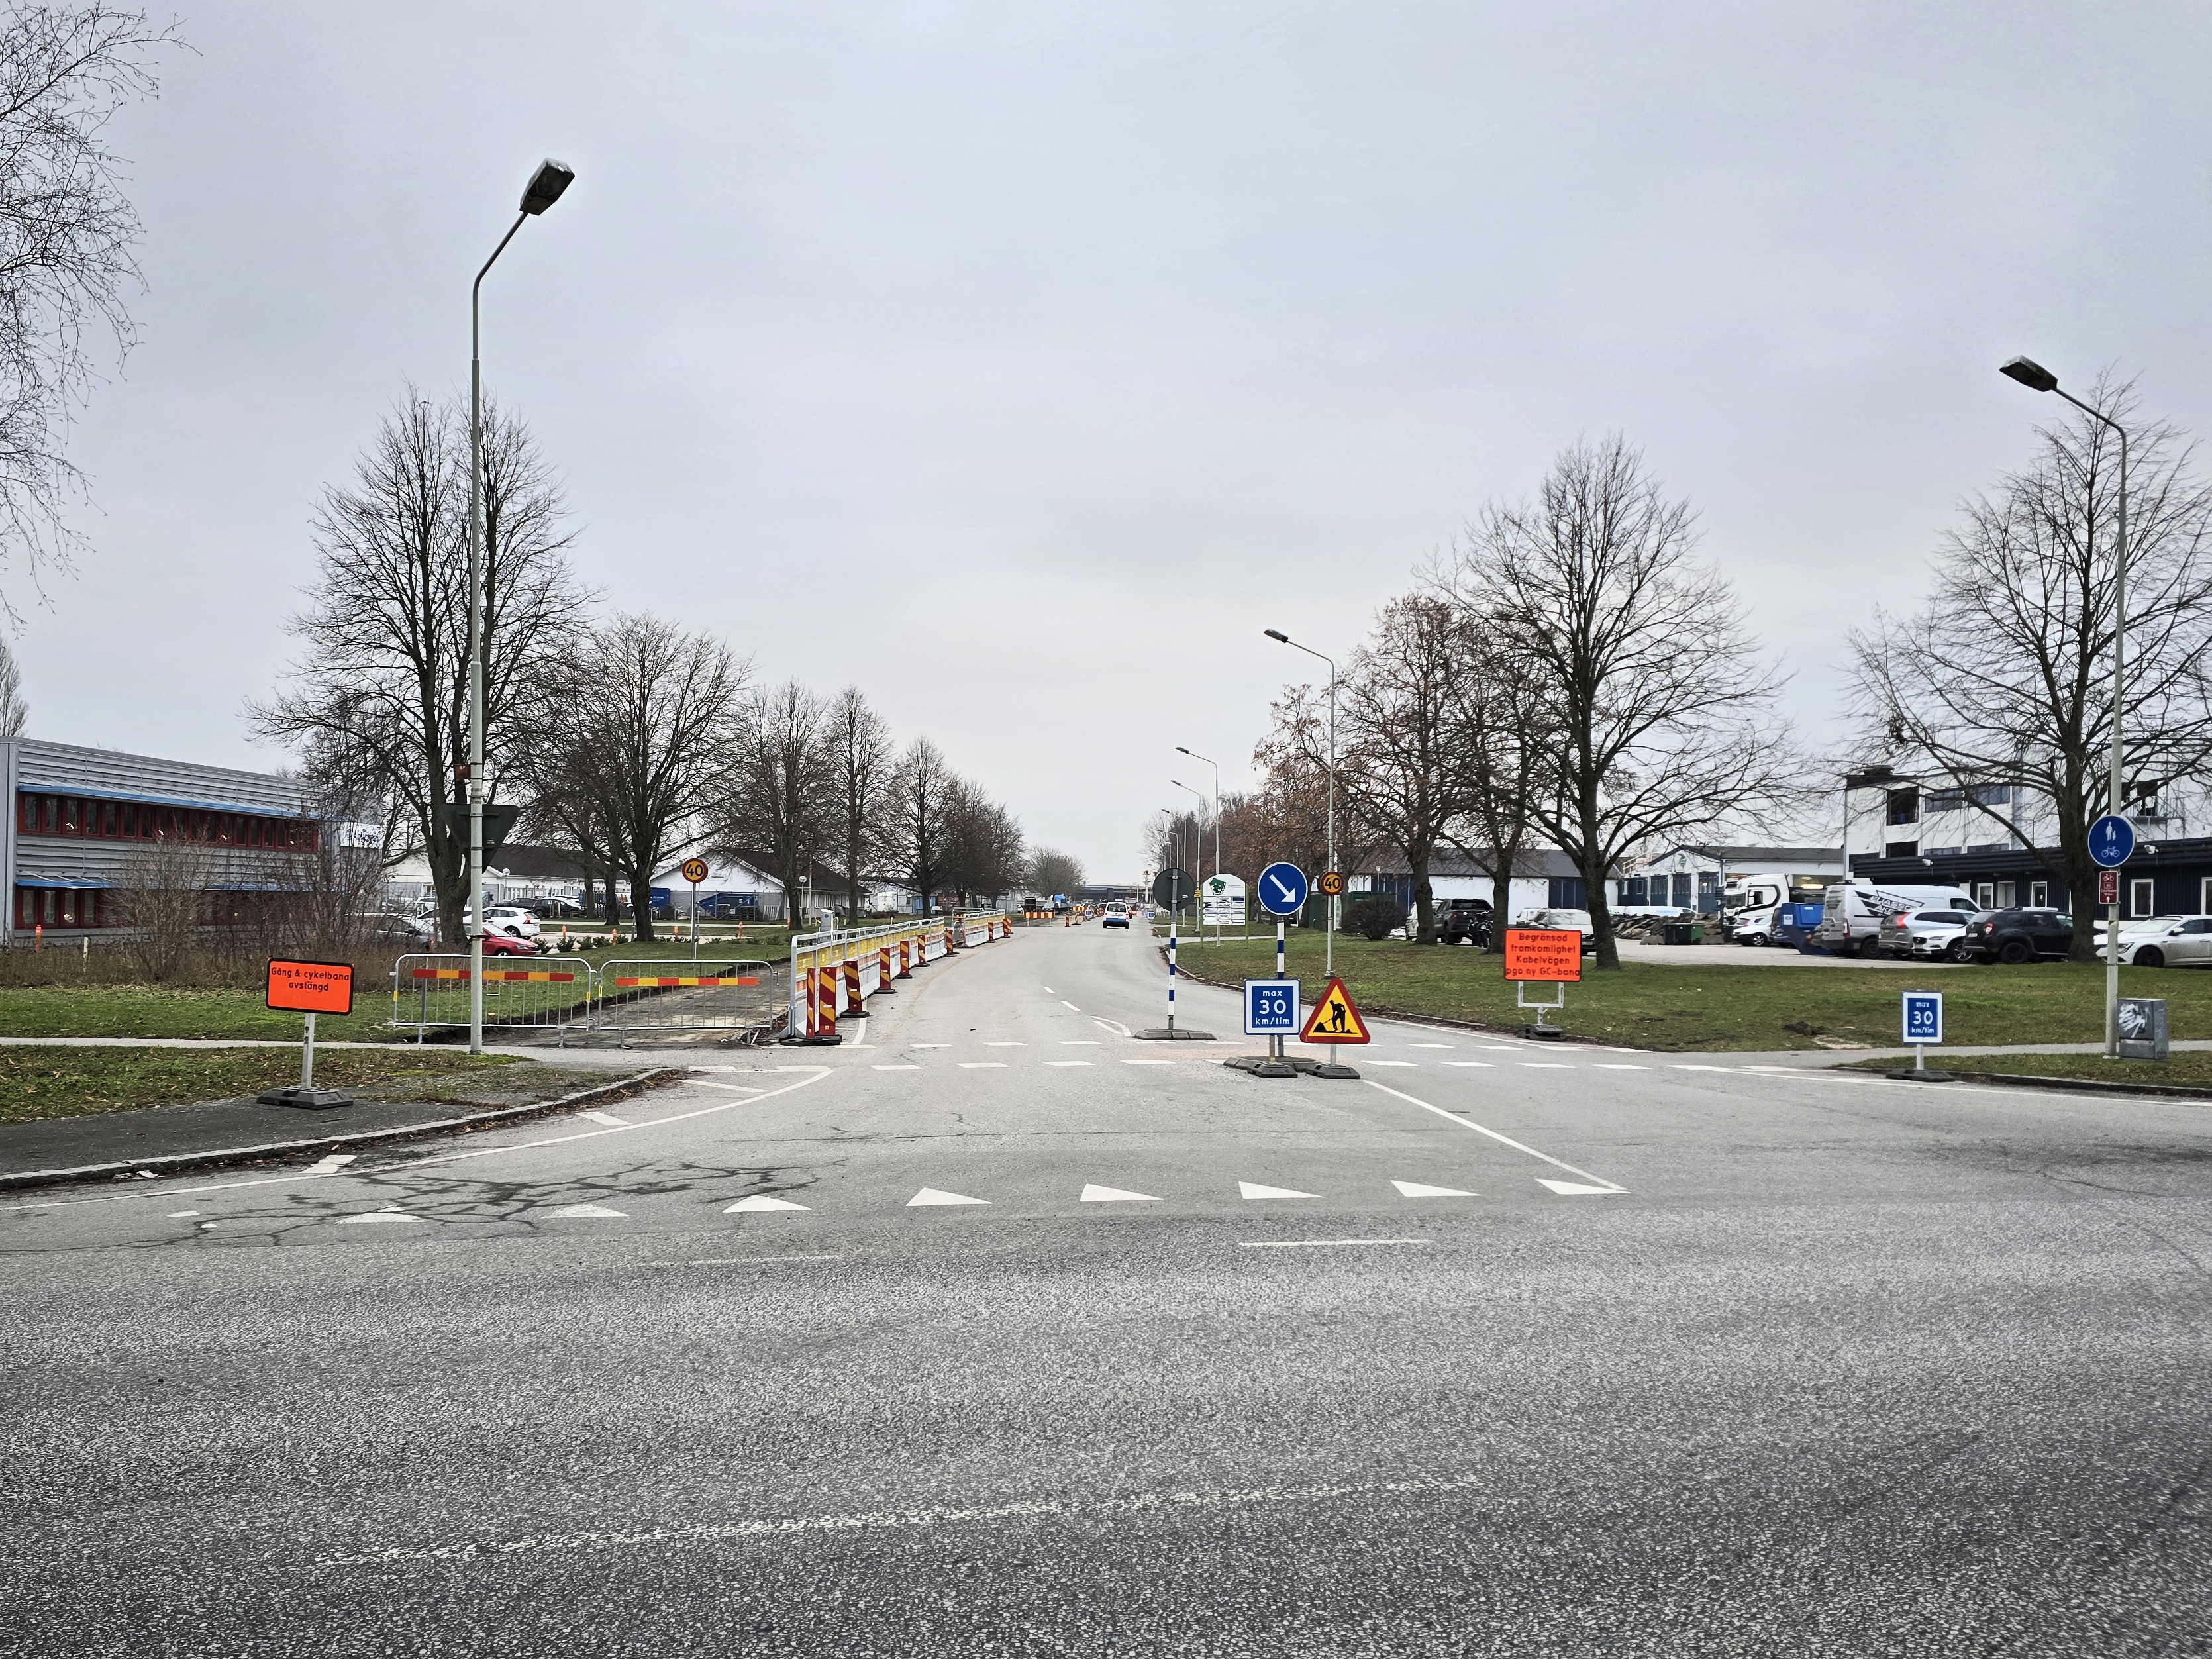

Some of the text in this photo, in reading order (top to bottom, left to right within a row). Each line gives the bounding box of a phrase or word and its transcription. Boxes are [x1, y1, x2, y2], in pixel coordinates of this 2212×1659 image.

[686, 864, 703, 877] 40
[1325, 878, 1341, 889] 40
[1870, 895, 1917, 911] ELIASSO
[1519, 933, 1568, 942] Begränsad
[1511, 944, 1576, 954] framkomlighet
[1516, 956, 1570, 966] Kabelvägen
[271, 967, 292, 978] Gång
[304, 970, 349, 981] cykelbana
[1540, 967, 1580, 976] GC-bana
[289, 981, 328, 993] avstängd
[1259, 999, 1287, 1015] 30
[1913, 1011, 1933, 1025] 30
